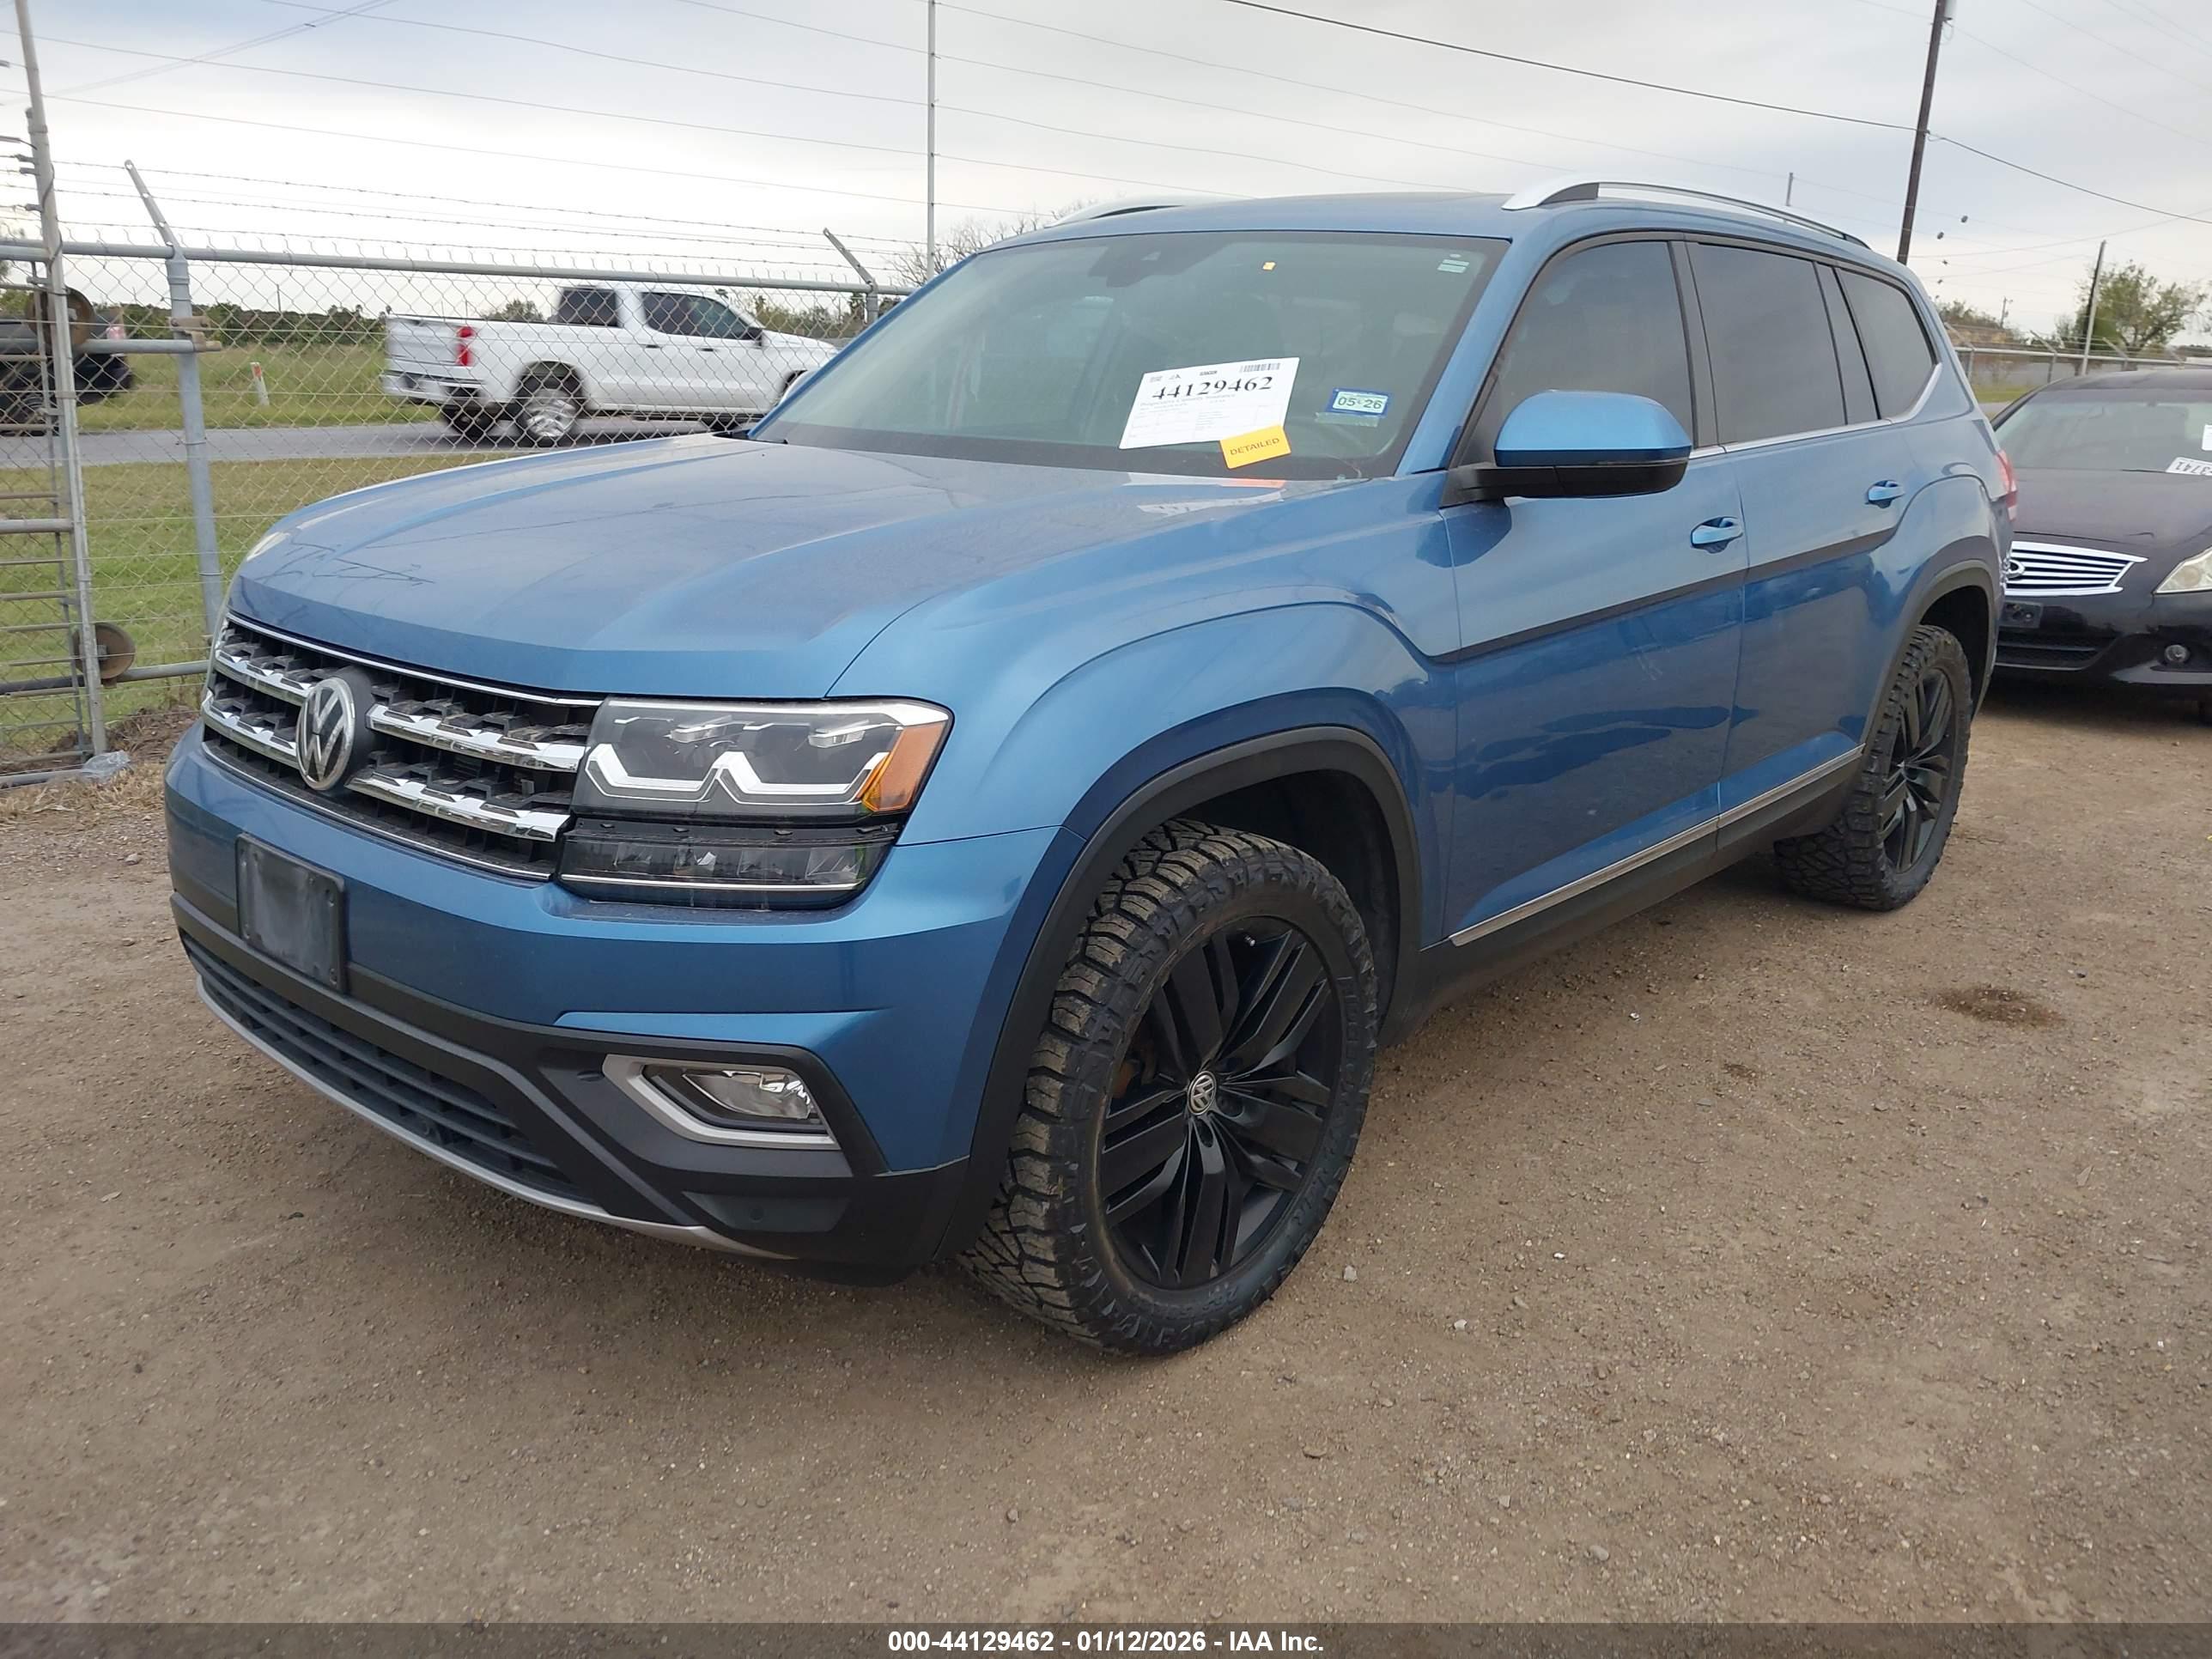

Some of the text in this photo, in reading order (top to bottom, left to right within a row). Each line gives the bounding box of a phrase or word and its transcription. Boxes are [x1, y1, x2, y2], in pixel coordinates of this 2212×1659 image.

[1152, 376, 1273, 399] 44129462
[1338, 397, 1382, 409] 05 26
[1230, 438, 1279, 455] DETAILED
[2175, 461, 2212, 475] 3741
